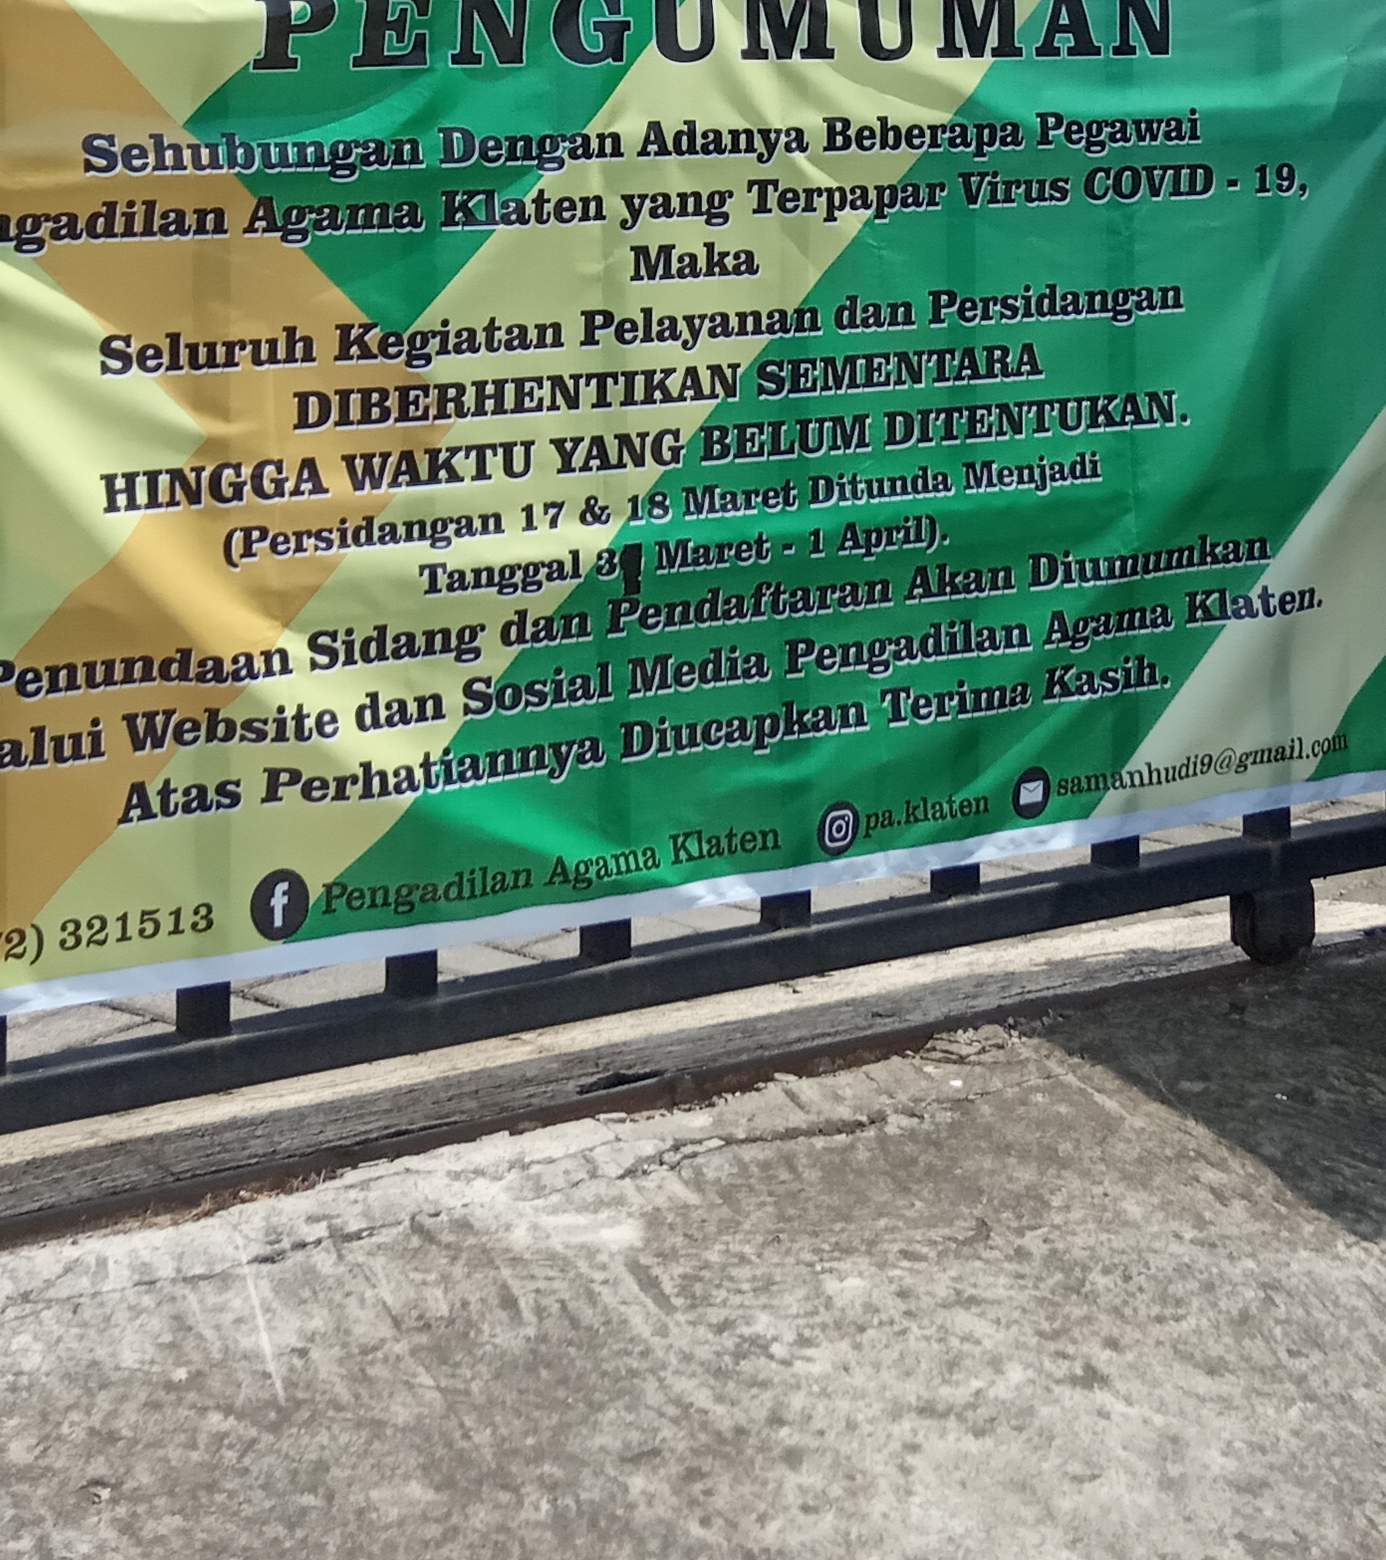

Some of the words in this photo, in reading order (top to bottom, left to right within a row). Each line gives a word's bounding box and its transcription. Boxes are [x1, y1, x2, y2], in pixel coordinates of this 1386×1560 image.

[82, 130, 424, 182] Sehubungan
[438, 122, 624, 174] Dengan
[637, 117, 809, 164] Adanya
[822, 113, 1025, 159] Beberapa
[1036, 107, 1201, 153] Pegawai
[243, 194, 425, 248] Agama
[441, 187, 608, 232] Klaten
[620, 187, 733, 232] yang
[746, 173, 948, 228] Terpapar
[958, 168, 1070, 211] Virus
[1083, 163, 1214, 204] COVID
[1253, 163, 1309, 202] 19,
[629, 242, 760, 284] Maka
[98, 325, 317, 379] Seluruh
[333, 313, 565, 370] Kegiatan
[581, 297, 822, 351] Pelayanan
[834, 294, 916, 334] dan
[928, 280, 1185, 326] Persidangan
[293, 362, 741, 432] DIBERHENTIKAN
[756, 342, 1044, 401] SEMENTARA
[100, 455, 330, 515] HINGGA
[342, 439, 535, 495] WAKTU
[549, 425, 684, 474] YANG
[699, 409, 872, 467] BELUM
[883, 390, 1191, 451] DITENTUKAN.
[222, 508, 505, 569] (Persidangan
[520, 499, 567, 532] 17
[579, 494, 613, 527] &
[626, 490, 672, 524] 18
[682, 479, 798, 519] Maret
[807, 464, 954, 509] Ditunda
[963, 451, 1103, 498] Menjadi
[417, 549, 585, 597] Tanggal
[654, 531, 771, 575] Maret
[808, 528, 827, 556] 1
[837, 514, 951, 559] April).
[306, 620, 487, 676] Sidang
[498, 602, 593, 647] dan
[606, 574, 892, 639] Pendaftaran
[905, 559, 1017, 606] Akan
[1028, 533, 1272, 592] Diumumkan
[121, 702, 342, 759] Website
[354, 685, 448, 733] dan
[461, 658, 614, 721] Sosial
[627, 644, 771, 700] Media
[784, 614, 1033, 678] Pengadilan
[1042, 603, 1174, 651] Agama
[1184, 583, 1325, 626] Klaten.
[117, 771, 244, 828] Atas
[259, 734, 606, 808] Perhatiannya
[619, 696, 869, 763] Diucapkan
[881, 673, 1033, 728] Terima
[1041, 654, 1172, 705] Kasih.
[58, 902, 216, 957] 321513
[320, 865, 535, 922] Pengadilan
[544, 848, 662, 895] Agama
[670, 821, 783, 868] Klaten
[863, 790, 992, 839] pa.klaten
[1055, 729, 1350, 801] samanhudi9@gmail.com
